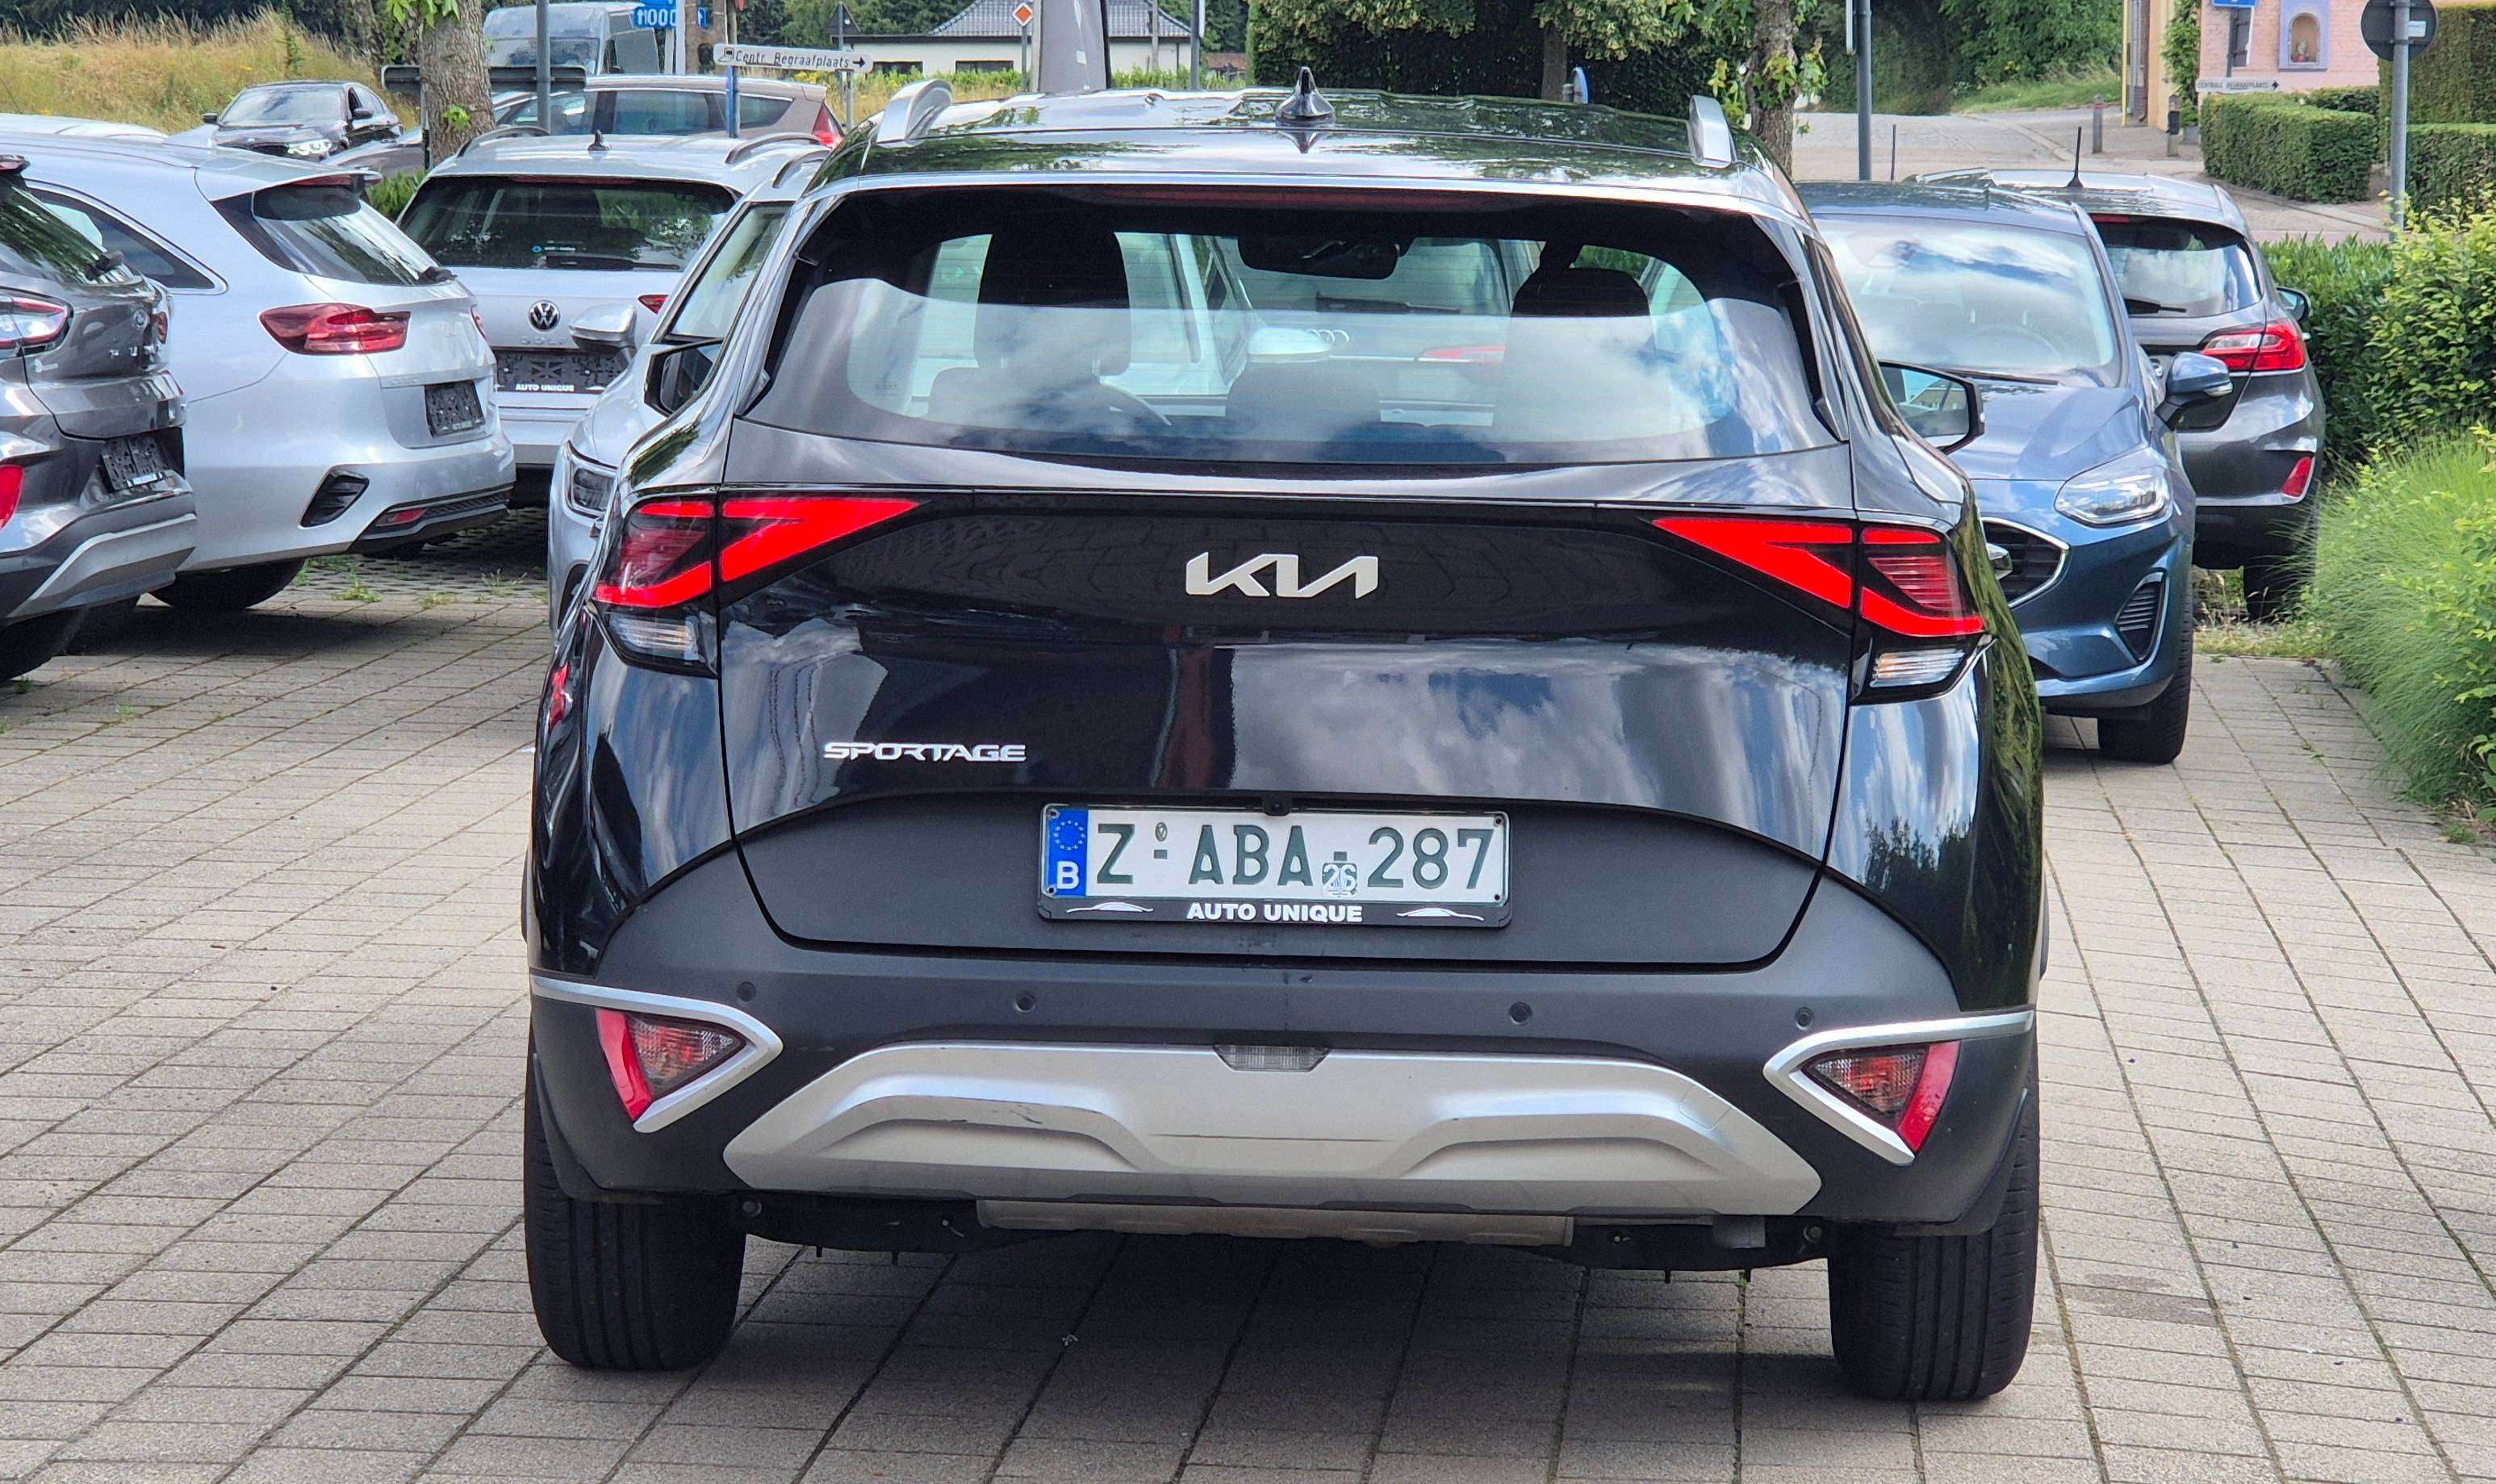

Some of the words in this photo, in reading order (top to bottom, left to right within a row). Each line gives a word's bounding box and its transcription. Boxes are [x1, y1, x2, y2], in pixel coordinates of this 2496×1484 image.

[774, 52, 849, 69] Begraafplaats
[1185, 551, 1378, 600] KIA
[823, 742, 1027, 763] SPORTAGE
[1056, 860, 1080, 890] B
[1186, 902, 1256, 921] AUTO
[1264, 903, 1363, 923] UNIQUE
